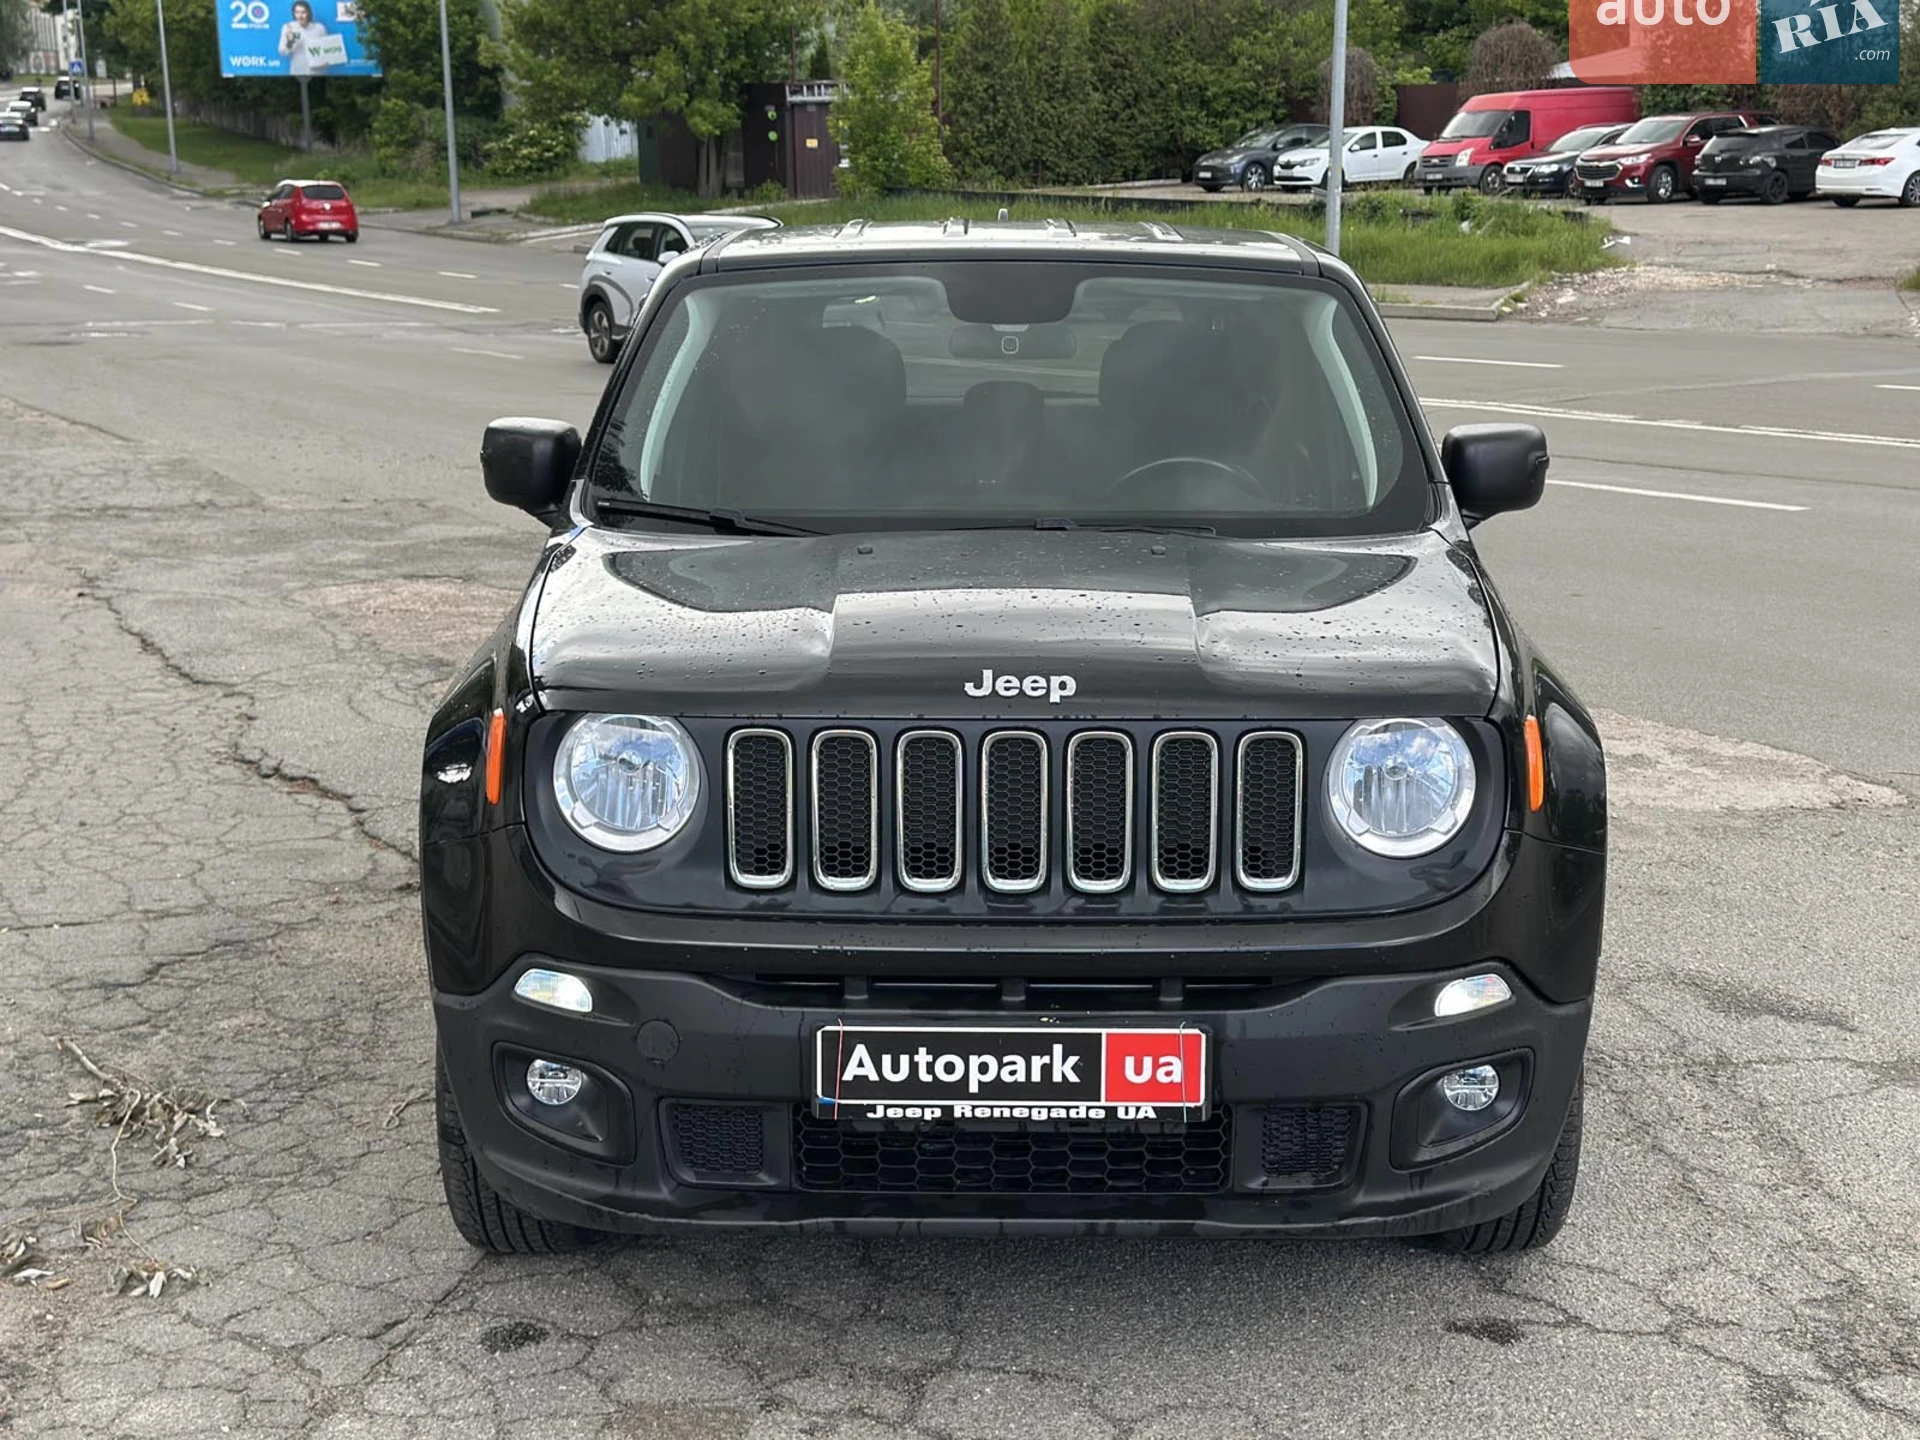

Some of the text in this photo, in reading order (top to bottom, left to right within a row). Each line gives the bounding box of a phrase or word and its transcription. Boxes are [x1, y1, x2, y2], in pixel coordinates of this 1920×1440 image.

[230, 1, 270, 23] 20
[964, 669, 1077, 703] Jeep
[841, 1043, 1183, 1093] Autopark ua
[866, 1104, 1158, 1121] Jeep Renegade UA
